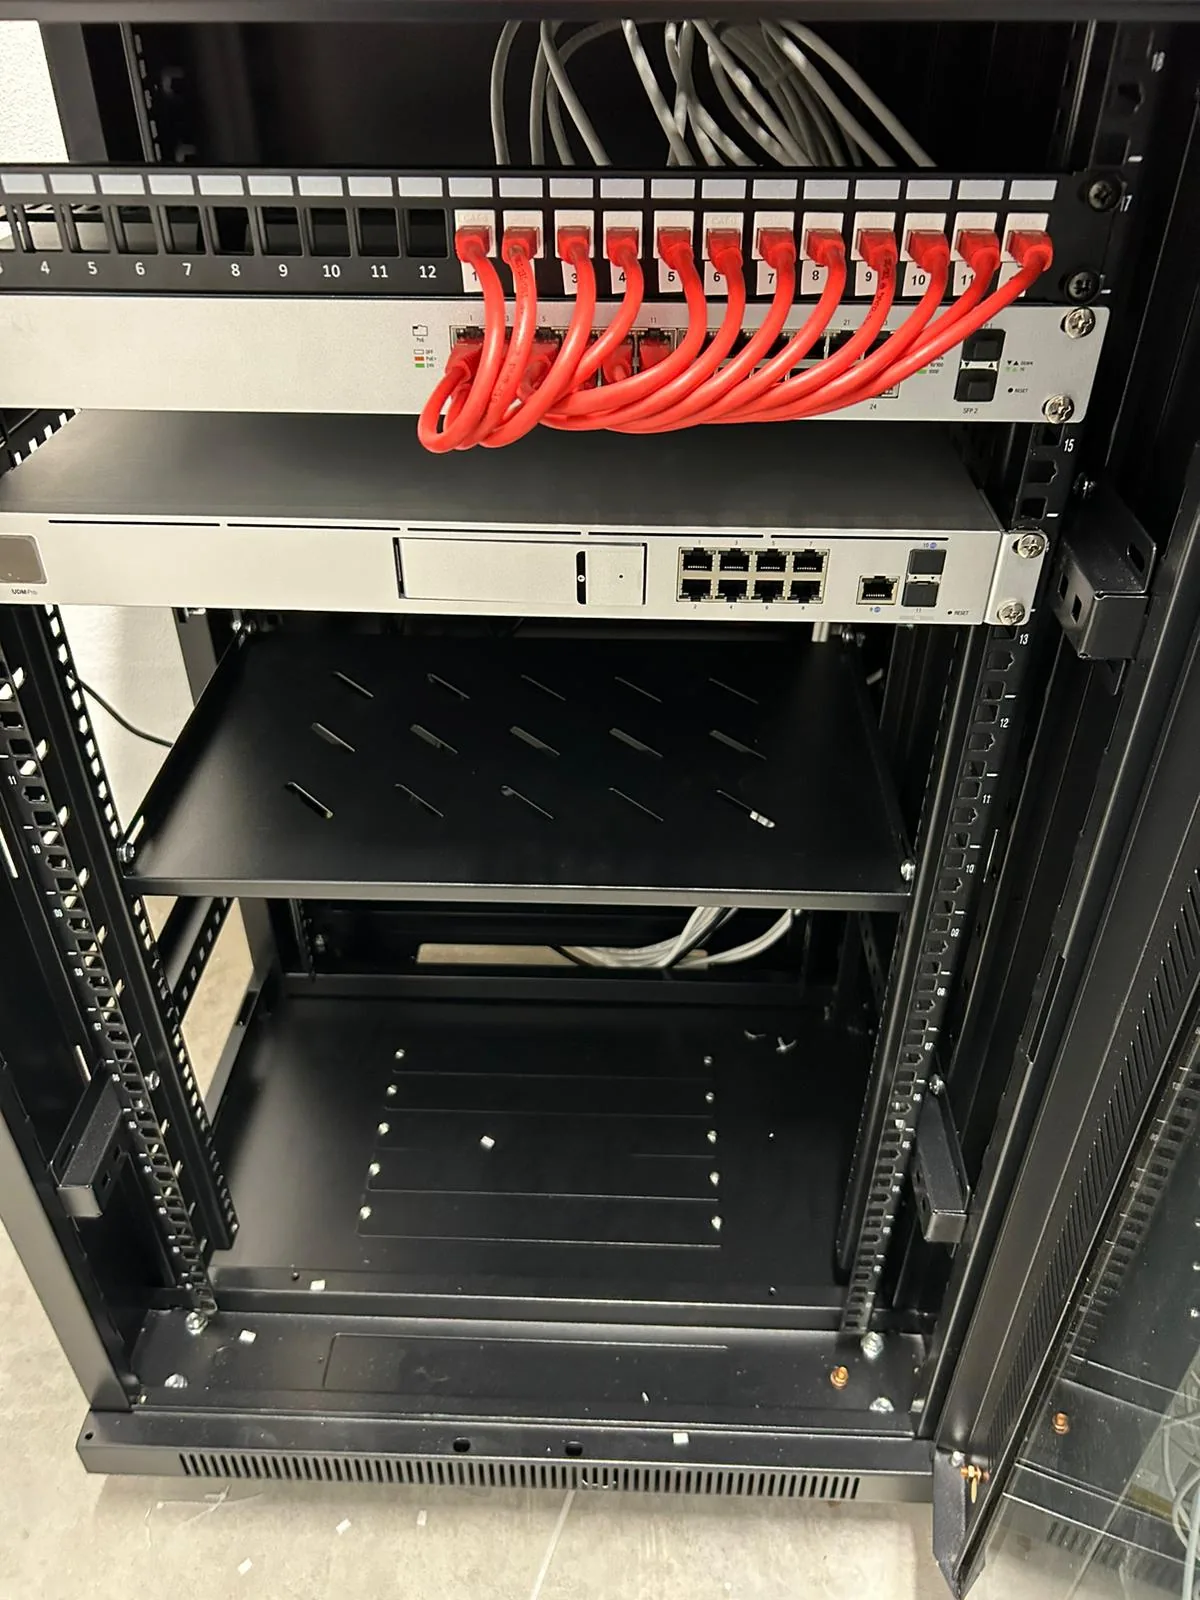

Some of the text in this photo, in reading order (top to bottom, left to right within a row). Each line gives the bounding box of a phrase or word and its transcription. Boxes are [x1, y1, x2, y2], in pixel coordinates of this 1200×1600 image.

[41, 261, 436, 279] 4 5 6 7 8 9 10 11 12
[812, 270, 820, 281] 8
[571, 273, 578, 284] 3
[619, 271, 626, 282] 4
[668, 271, 675, 282] 5
[714, 271, 721, 282] 6
[768, 273, 775, 284] 7
[865, 271, 873, 282] 9
[911, 275, 926, 286] 10
[1064, 438, 1075, 452] 15
[1019, 634, 1029, 645] 13
[1000, 718, 1009, 728] 12
[8, 776, 17, 785] 11
[983, 794, 992, 804] 11
[32, 845, 41, 854] 10
[966, 864, 975, 874] 10
